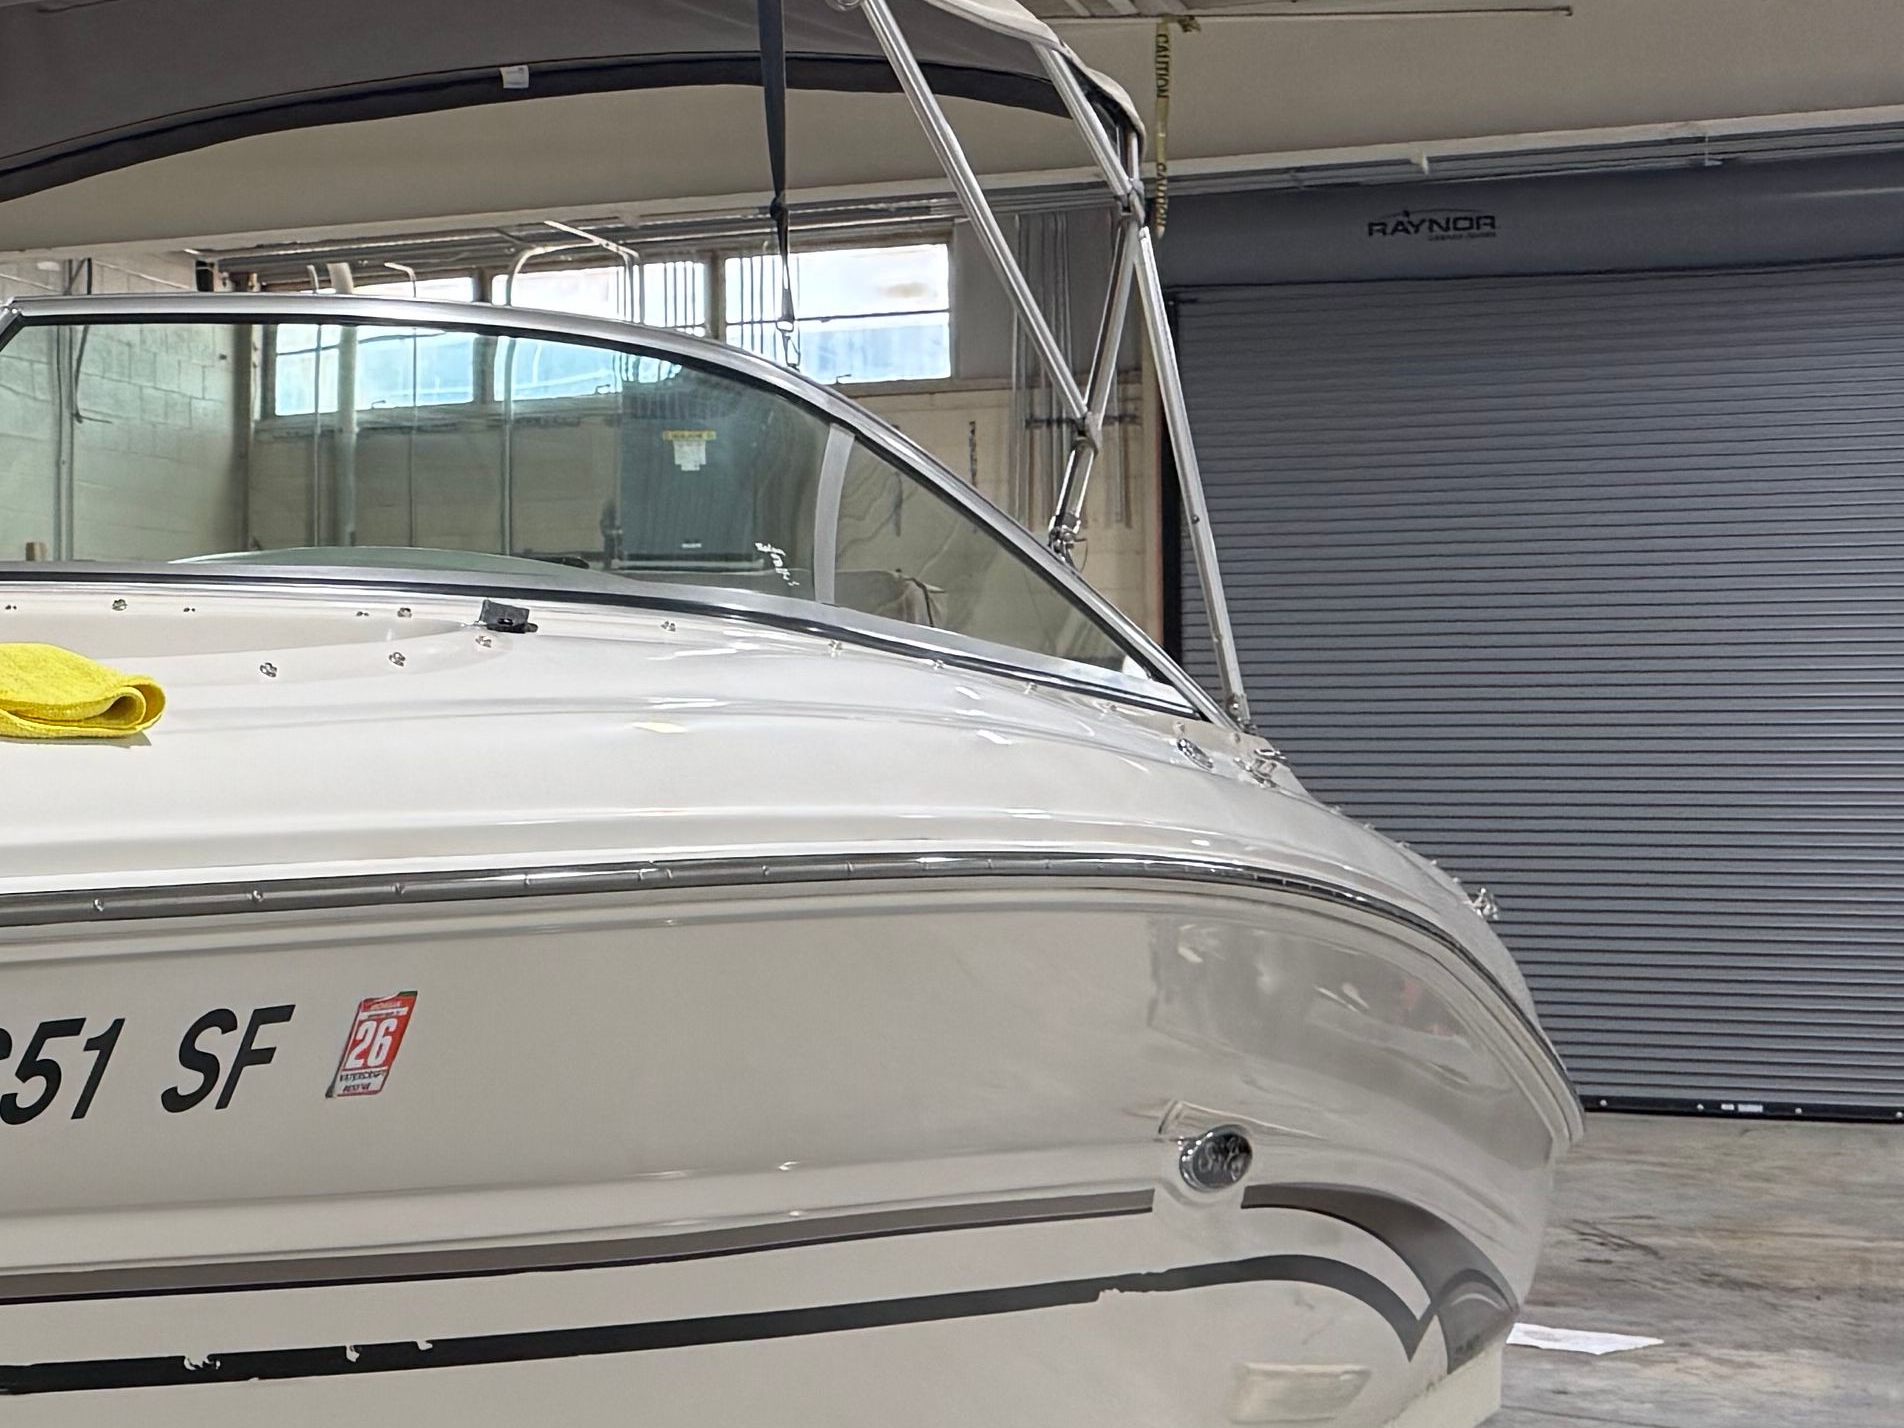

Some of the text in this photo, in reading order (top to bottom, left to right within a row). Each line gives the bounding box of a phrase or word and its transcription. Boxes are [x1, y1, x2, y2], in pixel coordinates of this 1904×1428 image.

[1155, 34, 1170, 98] CAUTION
[1367, 215, 1496, 236] RAYNOR
[161, 1005, 295, 1113] SF
[344, 1018, 398, 1069] 26
